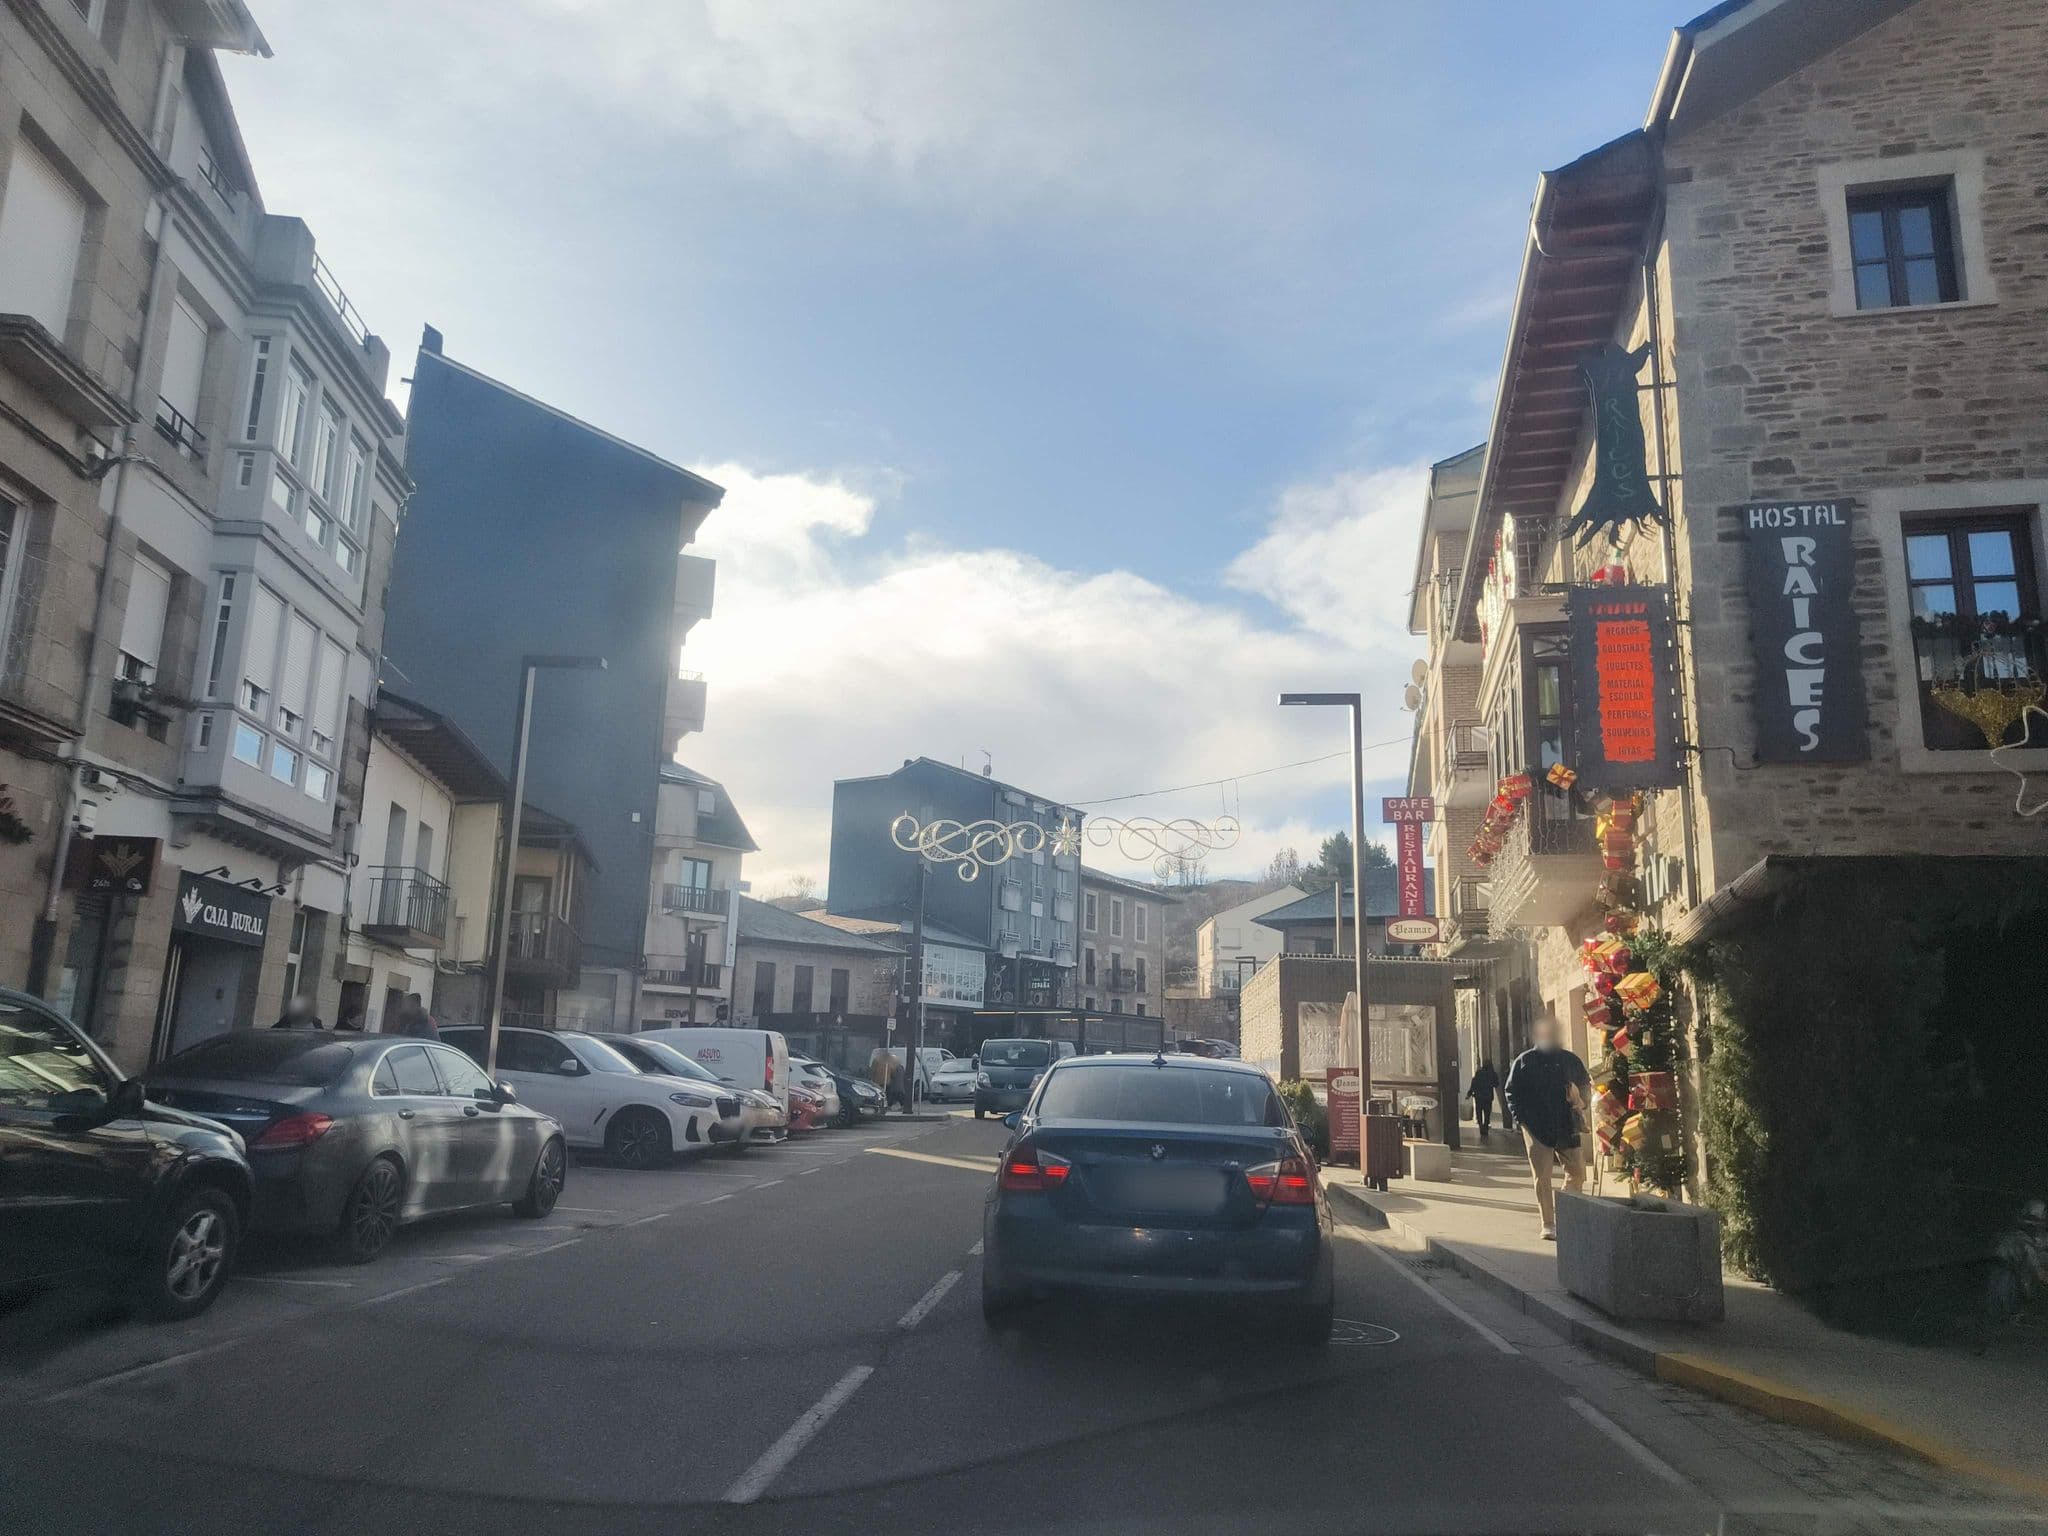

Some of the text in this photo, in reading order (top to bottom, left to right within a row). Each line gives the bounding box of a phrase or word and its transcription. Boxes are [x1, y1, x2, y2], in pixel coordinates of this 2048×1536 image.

[1749, 505, 1846, 528] HOSTAL
[1781, 536, 1825, 752] RAICES
[1606, 661, 1644, 671] JUGUETES
[1606, 679, 1645, 689] MATERIAL
[1609, 692, 1644, 701] ESCOLAR
[1606, 727, 1651, 738] SOUVENIRS
[1618, 746, 1642, 755] JOYAS
[1388, 799, 1429, 809] CAFE
[1393, 810, 1425, 820] BAR
[1403, 824, 1418, 916] RESTAURANTE
[203, 904, 264, 936] CAJA RURAL
